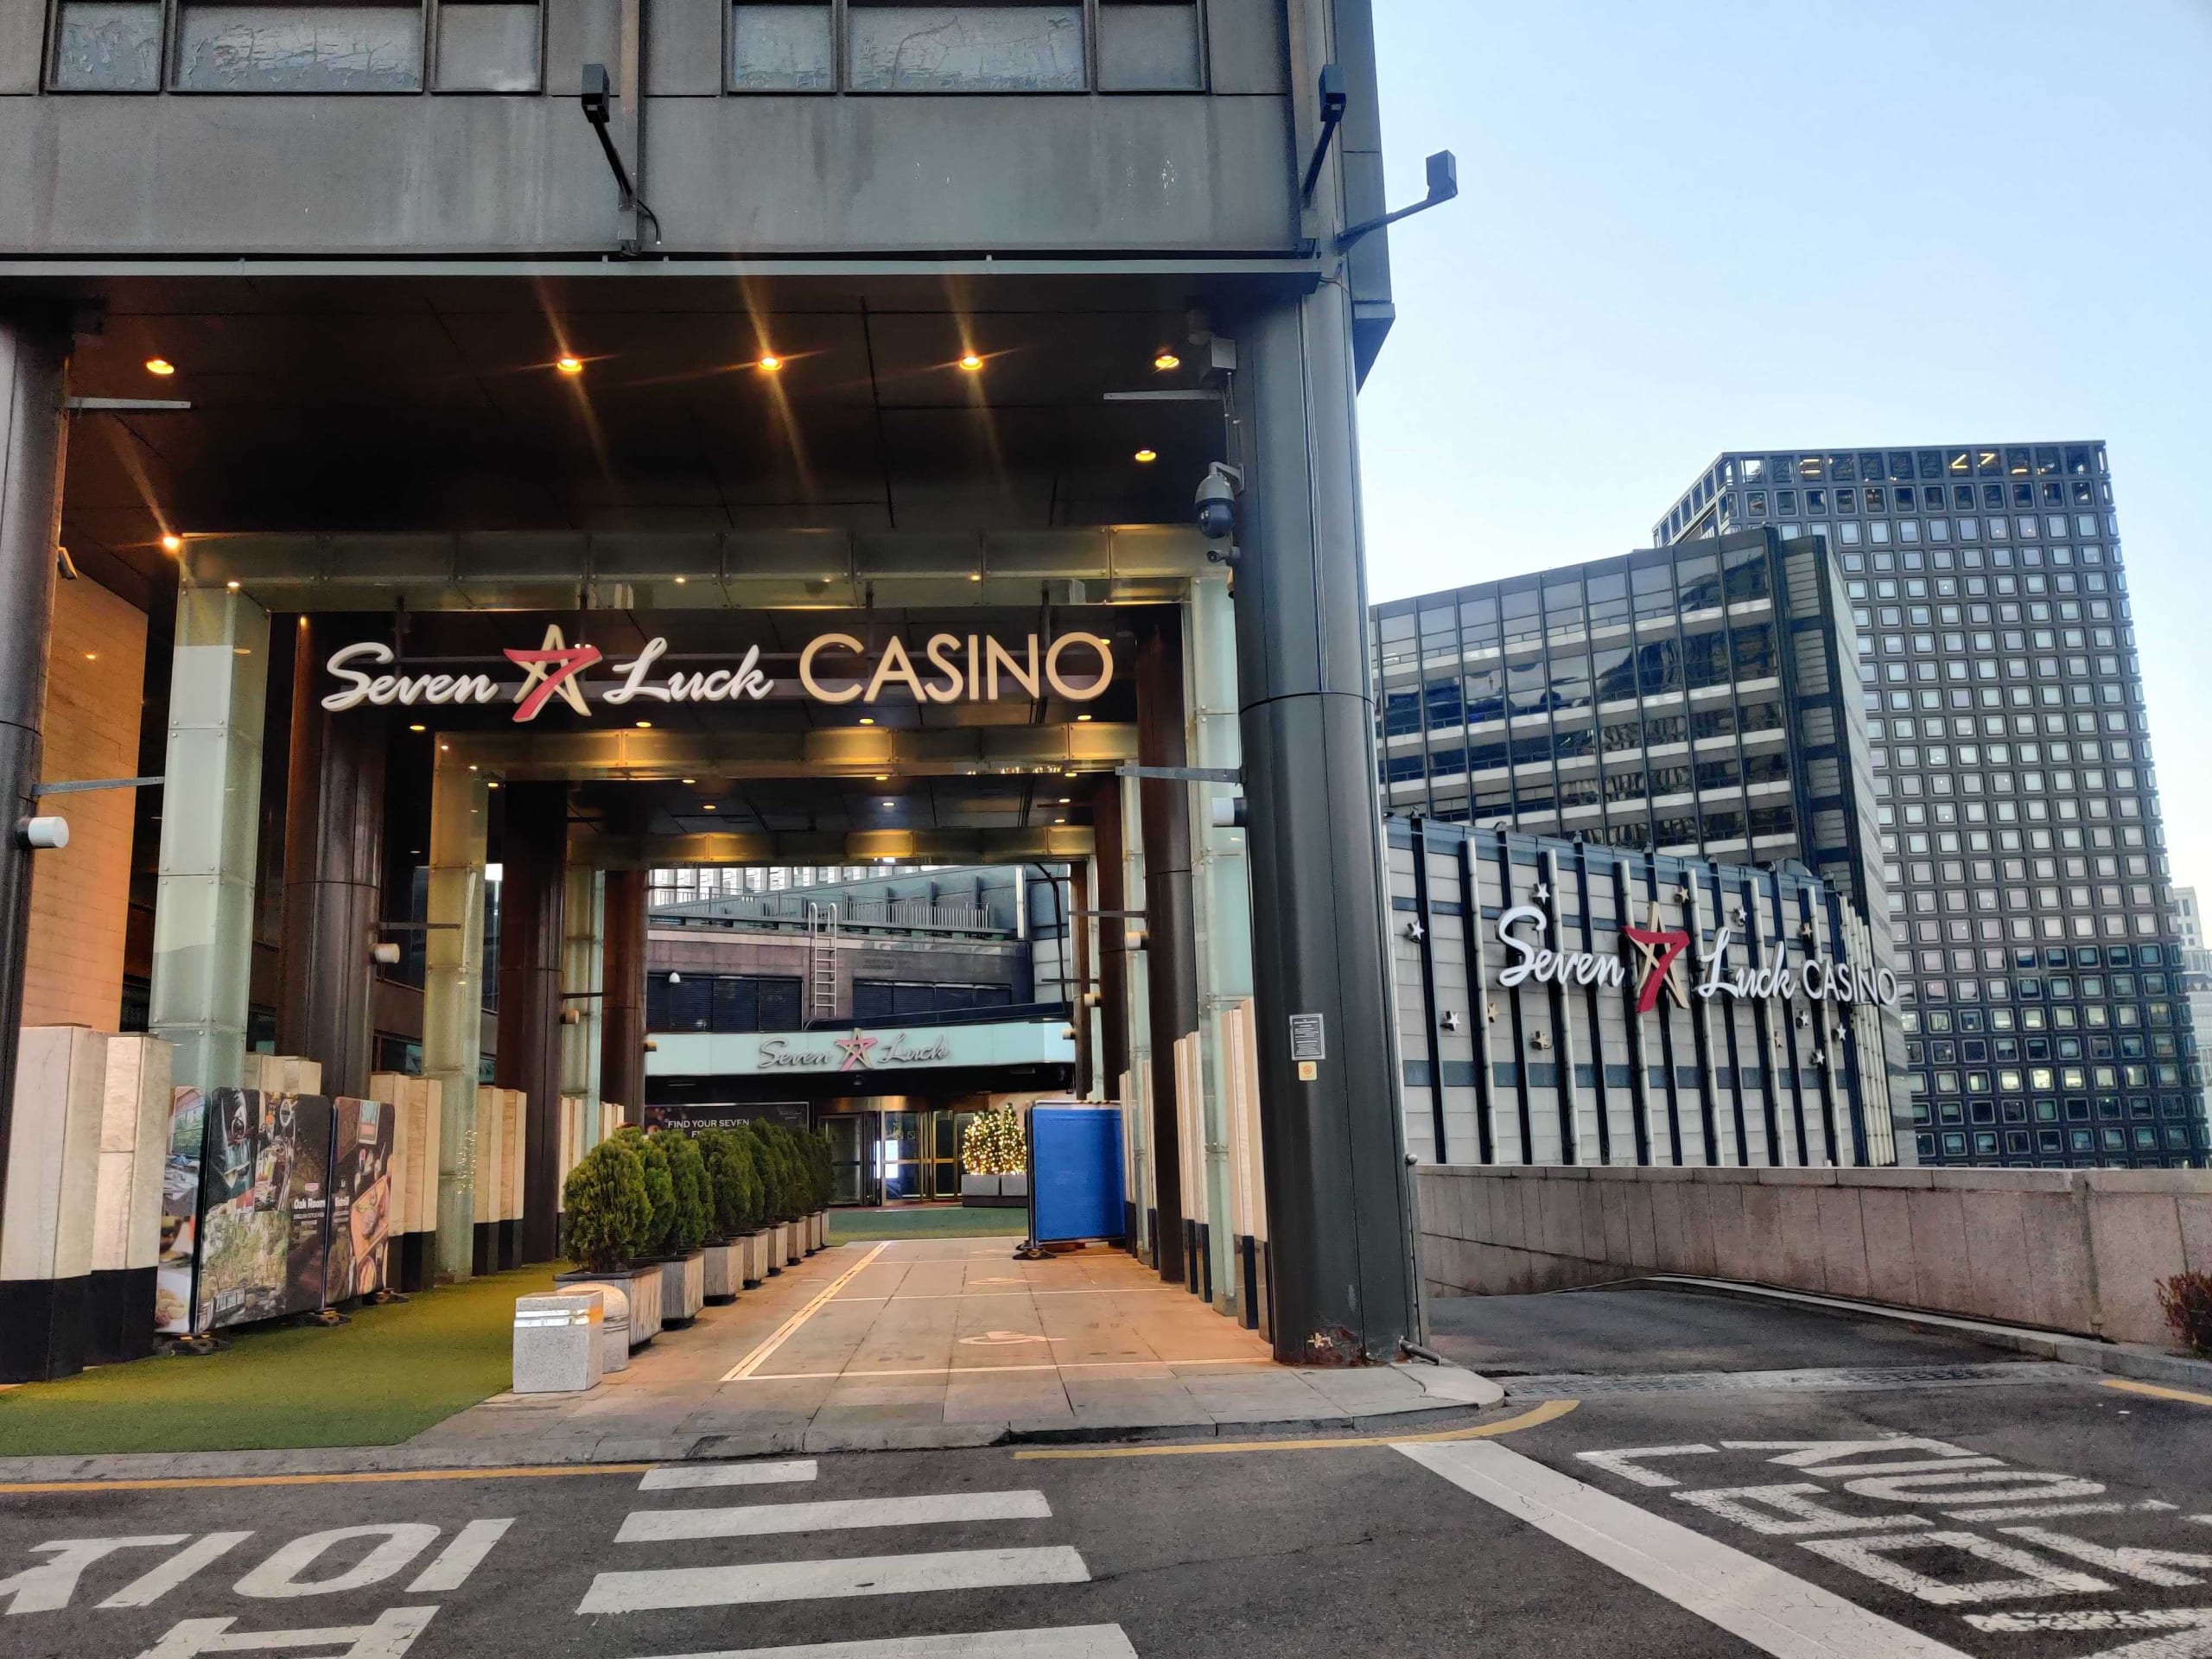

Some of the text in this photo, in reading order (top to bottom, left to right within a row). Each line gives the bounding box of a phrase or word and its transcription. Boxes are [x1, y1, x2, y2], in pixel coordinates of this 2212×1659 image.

[321, 642, 499, 712] Seven
[602, 636, 774, 702] Luck
[798, 632, 1116, 703] CASINO
[1496, 905, 1625, 988] Seven
[1695, 925, 1798, 1000] Luck
[1799, 957, 1898, 1006] CASINO
[757, 1038, 831, 1069] Seven
[876, 1032, 950, 1064] Luck
[667, 1118, 750, 1128] FIND YOUR SEVEN
[294, 1198, 307, 1210] Oak
[308, 1198, 326, 1209] Room
